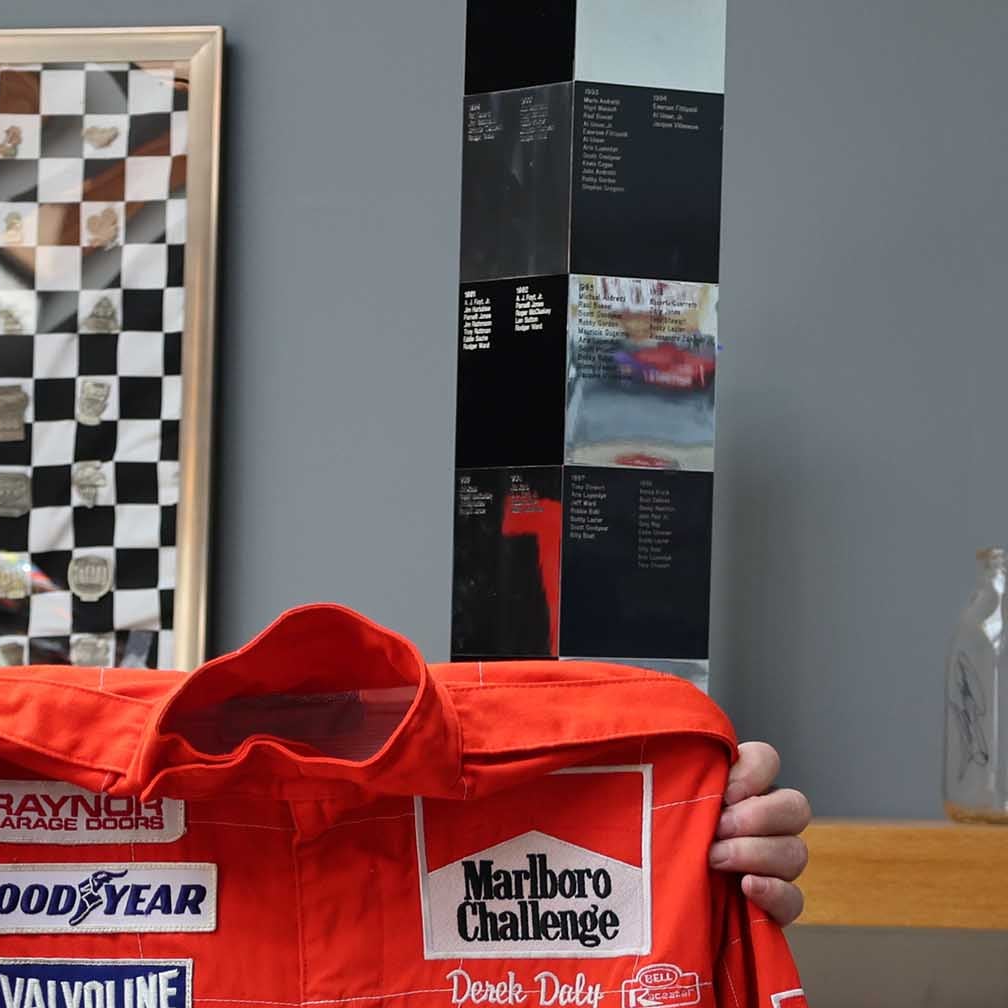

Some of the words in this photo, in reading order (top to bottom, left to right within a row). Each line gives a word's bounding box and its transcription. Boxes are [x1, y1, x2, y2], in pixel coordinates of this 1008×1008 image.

[86, 817, 165, 832] DOORS
[462, 853, 613, 900] Marlboro
[456, 900, 620, 948] Challenge
[445, 969, 528, 1006] Derek
[643, 972, 674, 985] BELL
